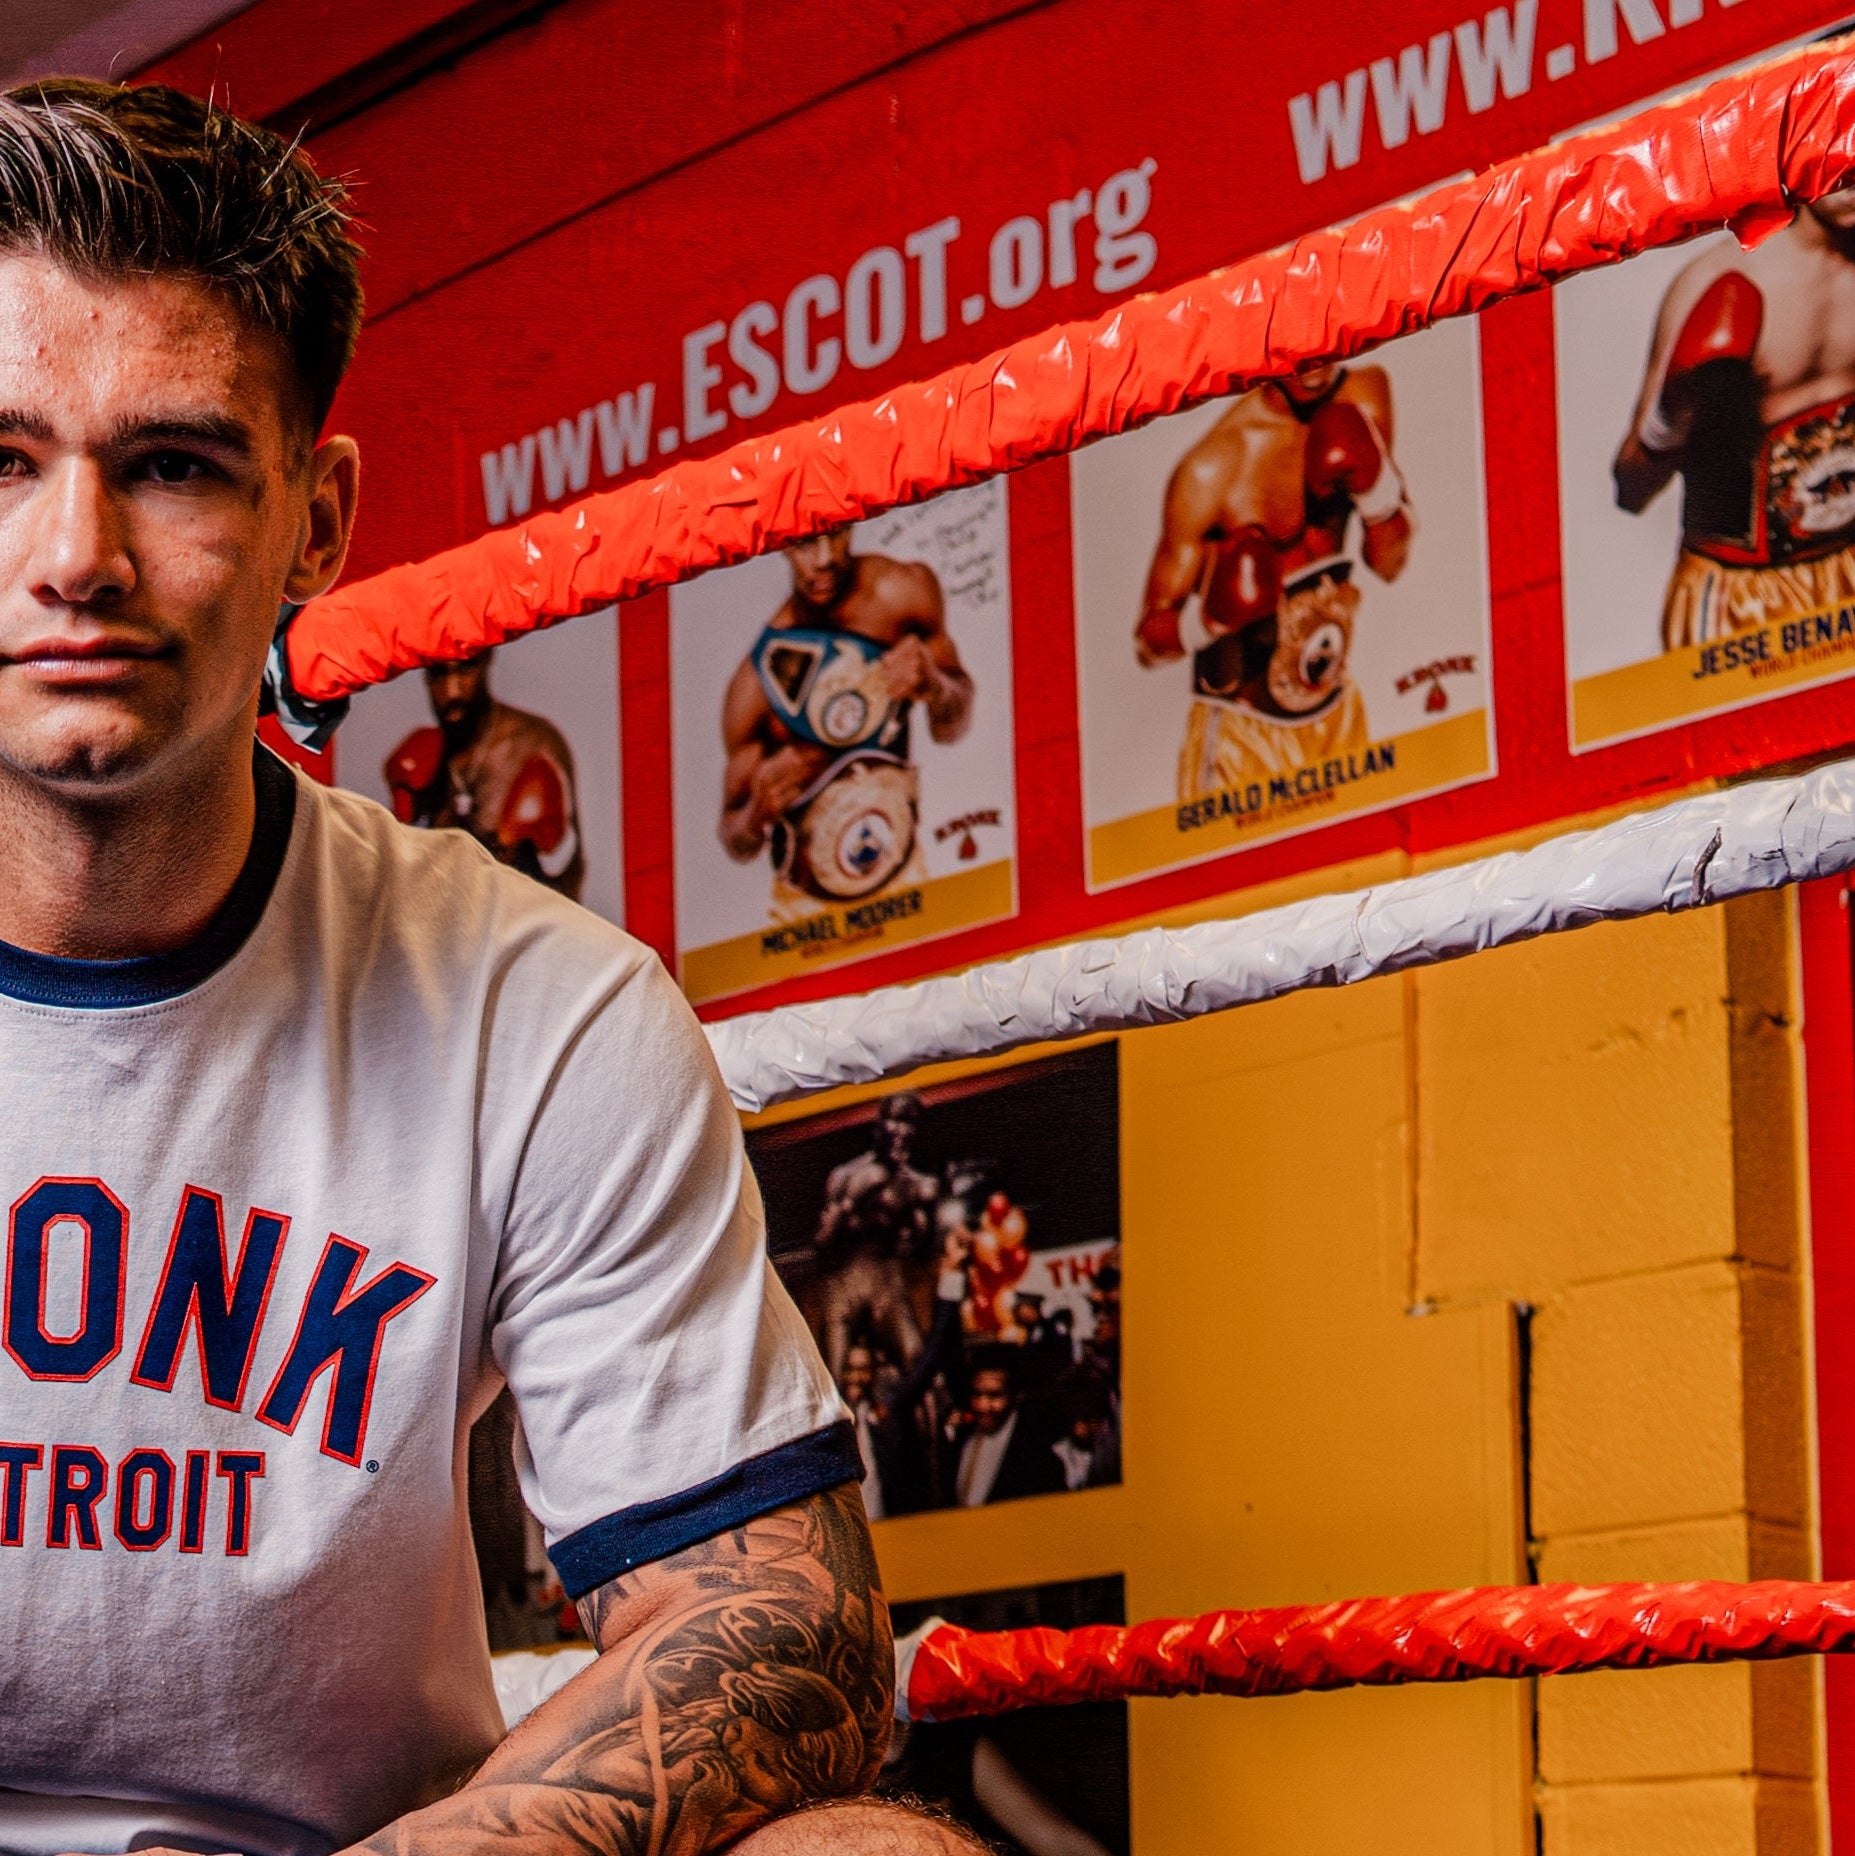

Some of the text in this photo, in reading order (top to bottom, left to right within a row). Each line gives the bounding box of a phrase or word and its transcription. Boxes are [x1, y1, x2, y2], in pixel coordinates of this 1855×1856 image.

[479, 157, 1157, 525] www.ESCOT.org
[1692, 605, 1855, 679] JESSE BENA
[1175, 784, 1264, 833] GERALD
